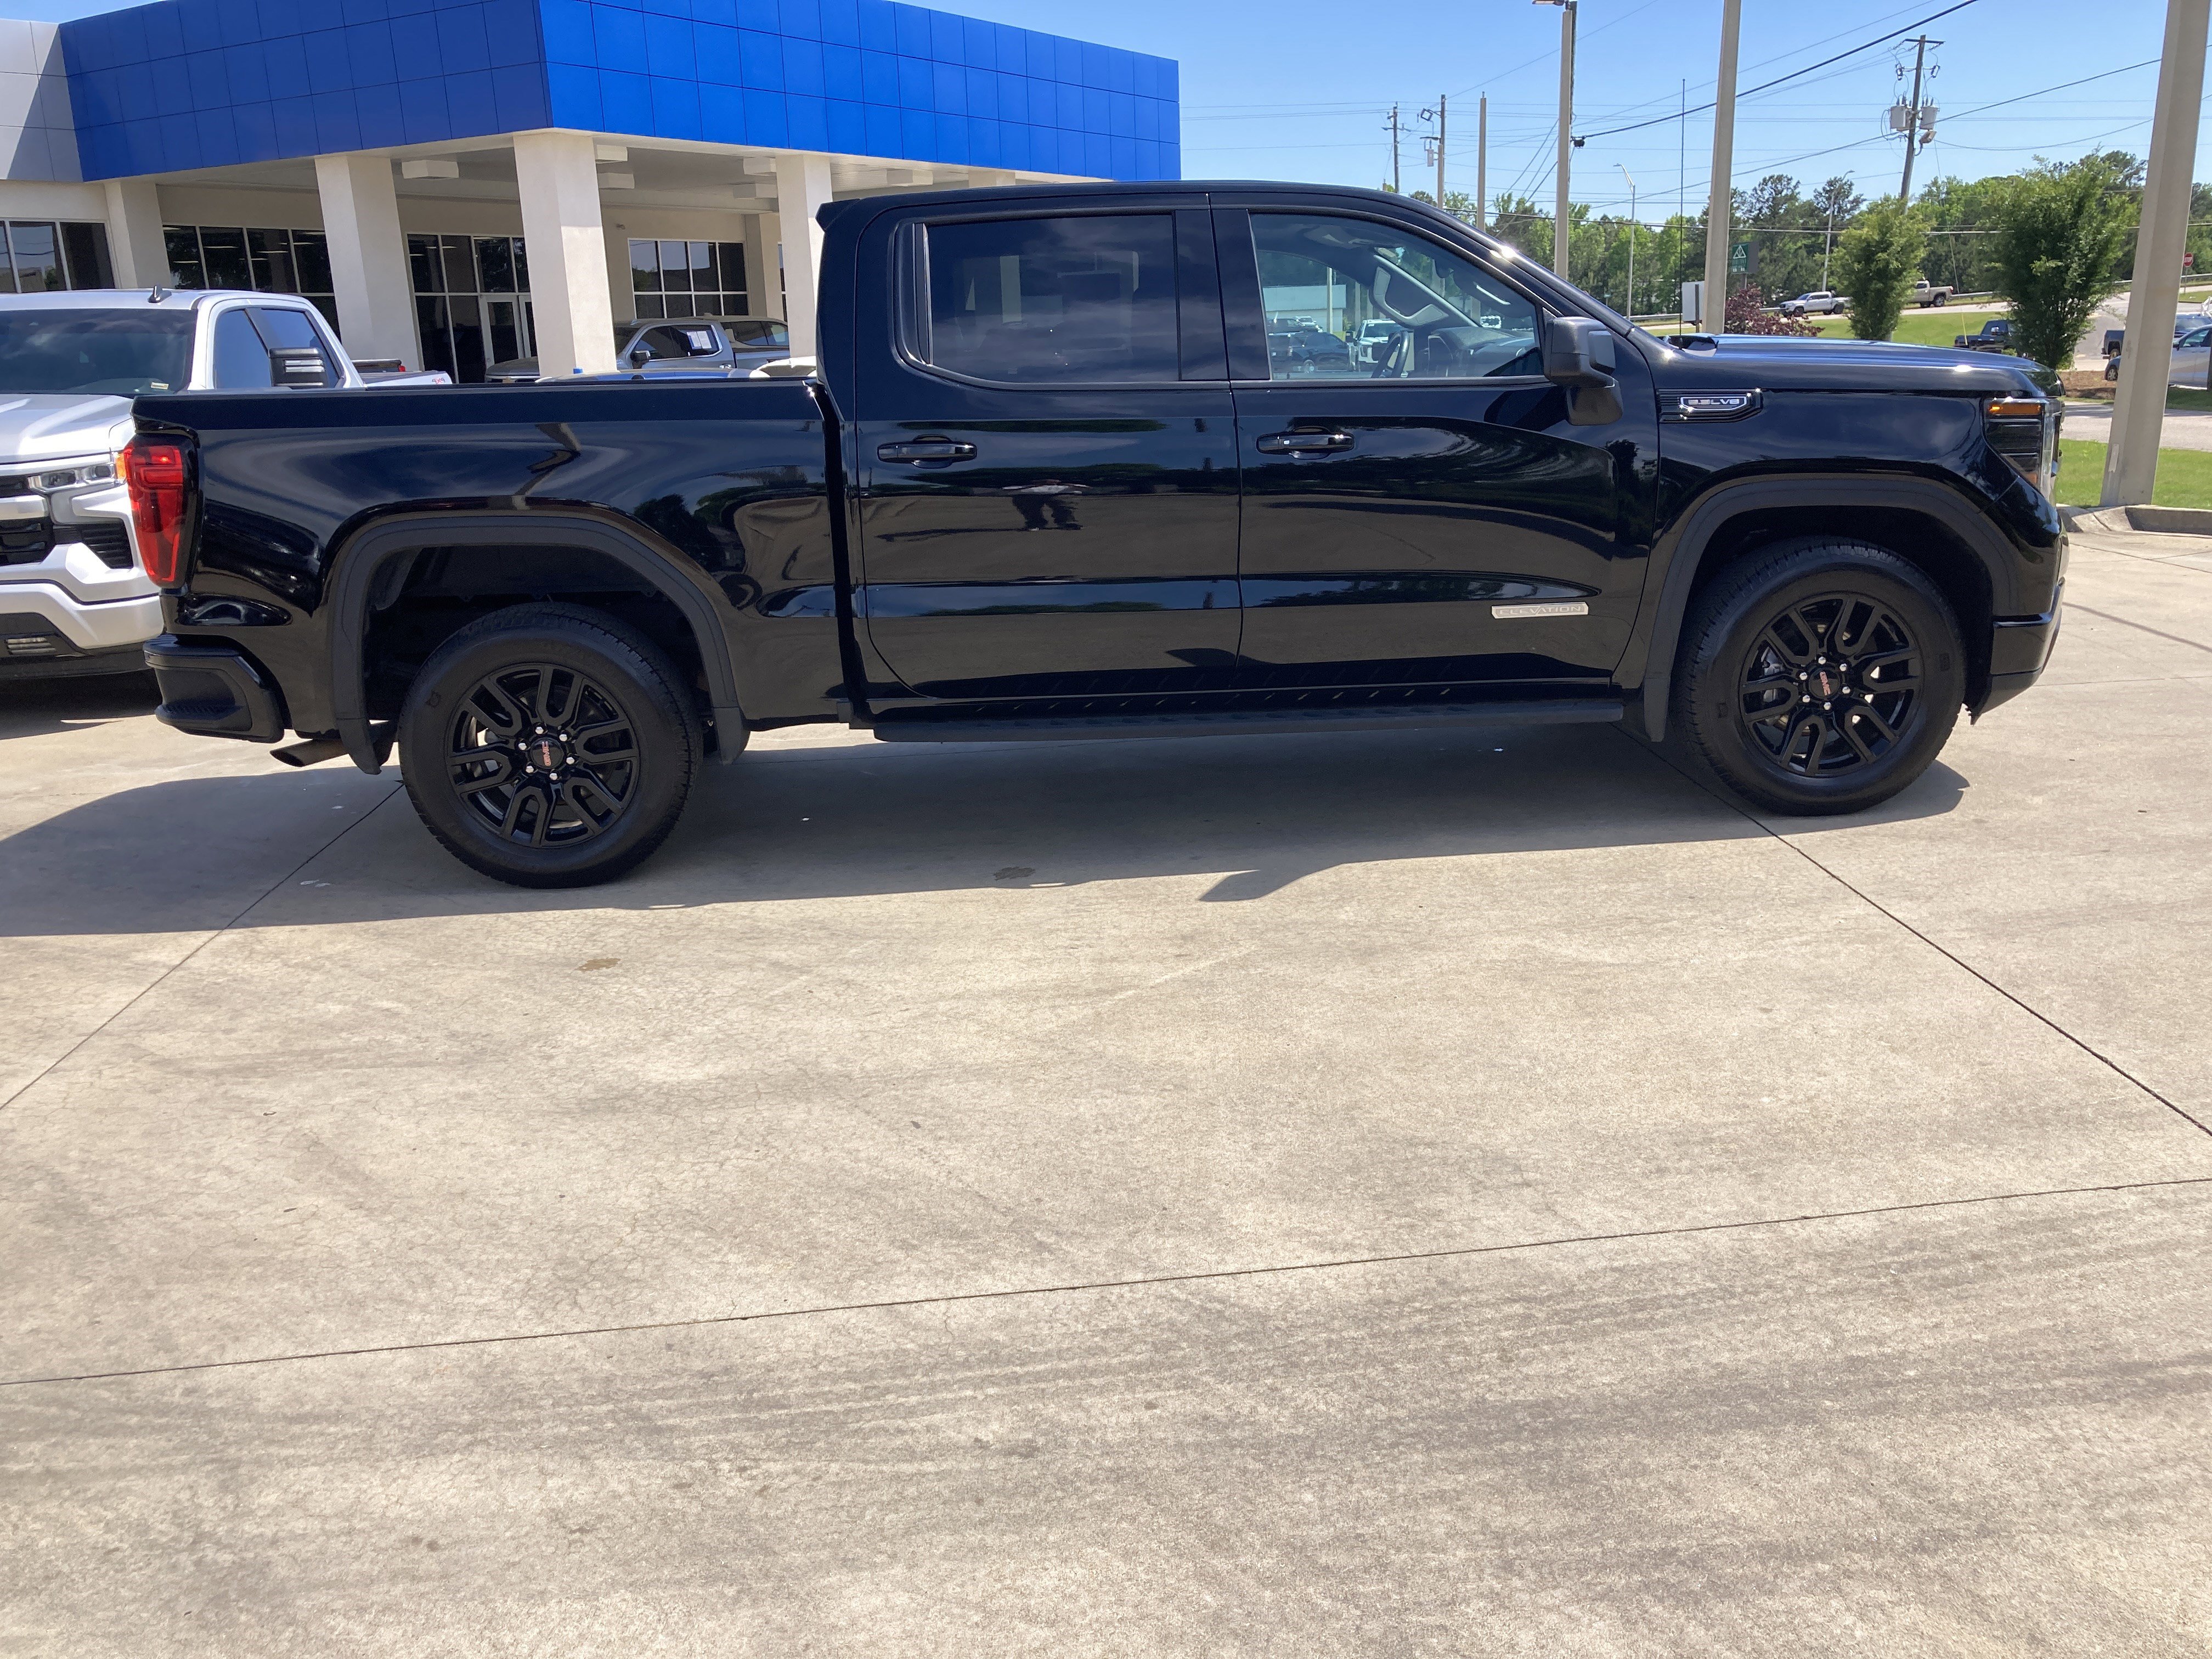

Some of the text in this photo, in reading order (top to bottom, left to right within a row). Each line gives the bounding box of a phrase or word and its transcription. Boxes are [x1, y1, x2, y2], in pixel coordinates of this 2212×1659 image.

[1499, 606, 1581, 615] ELEVATION
[1819, 671, 1831, 696] GMC
[541, 741, 551, 766] GMC
